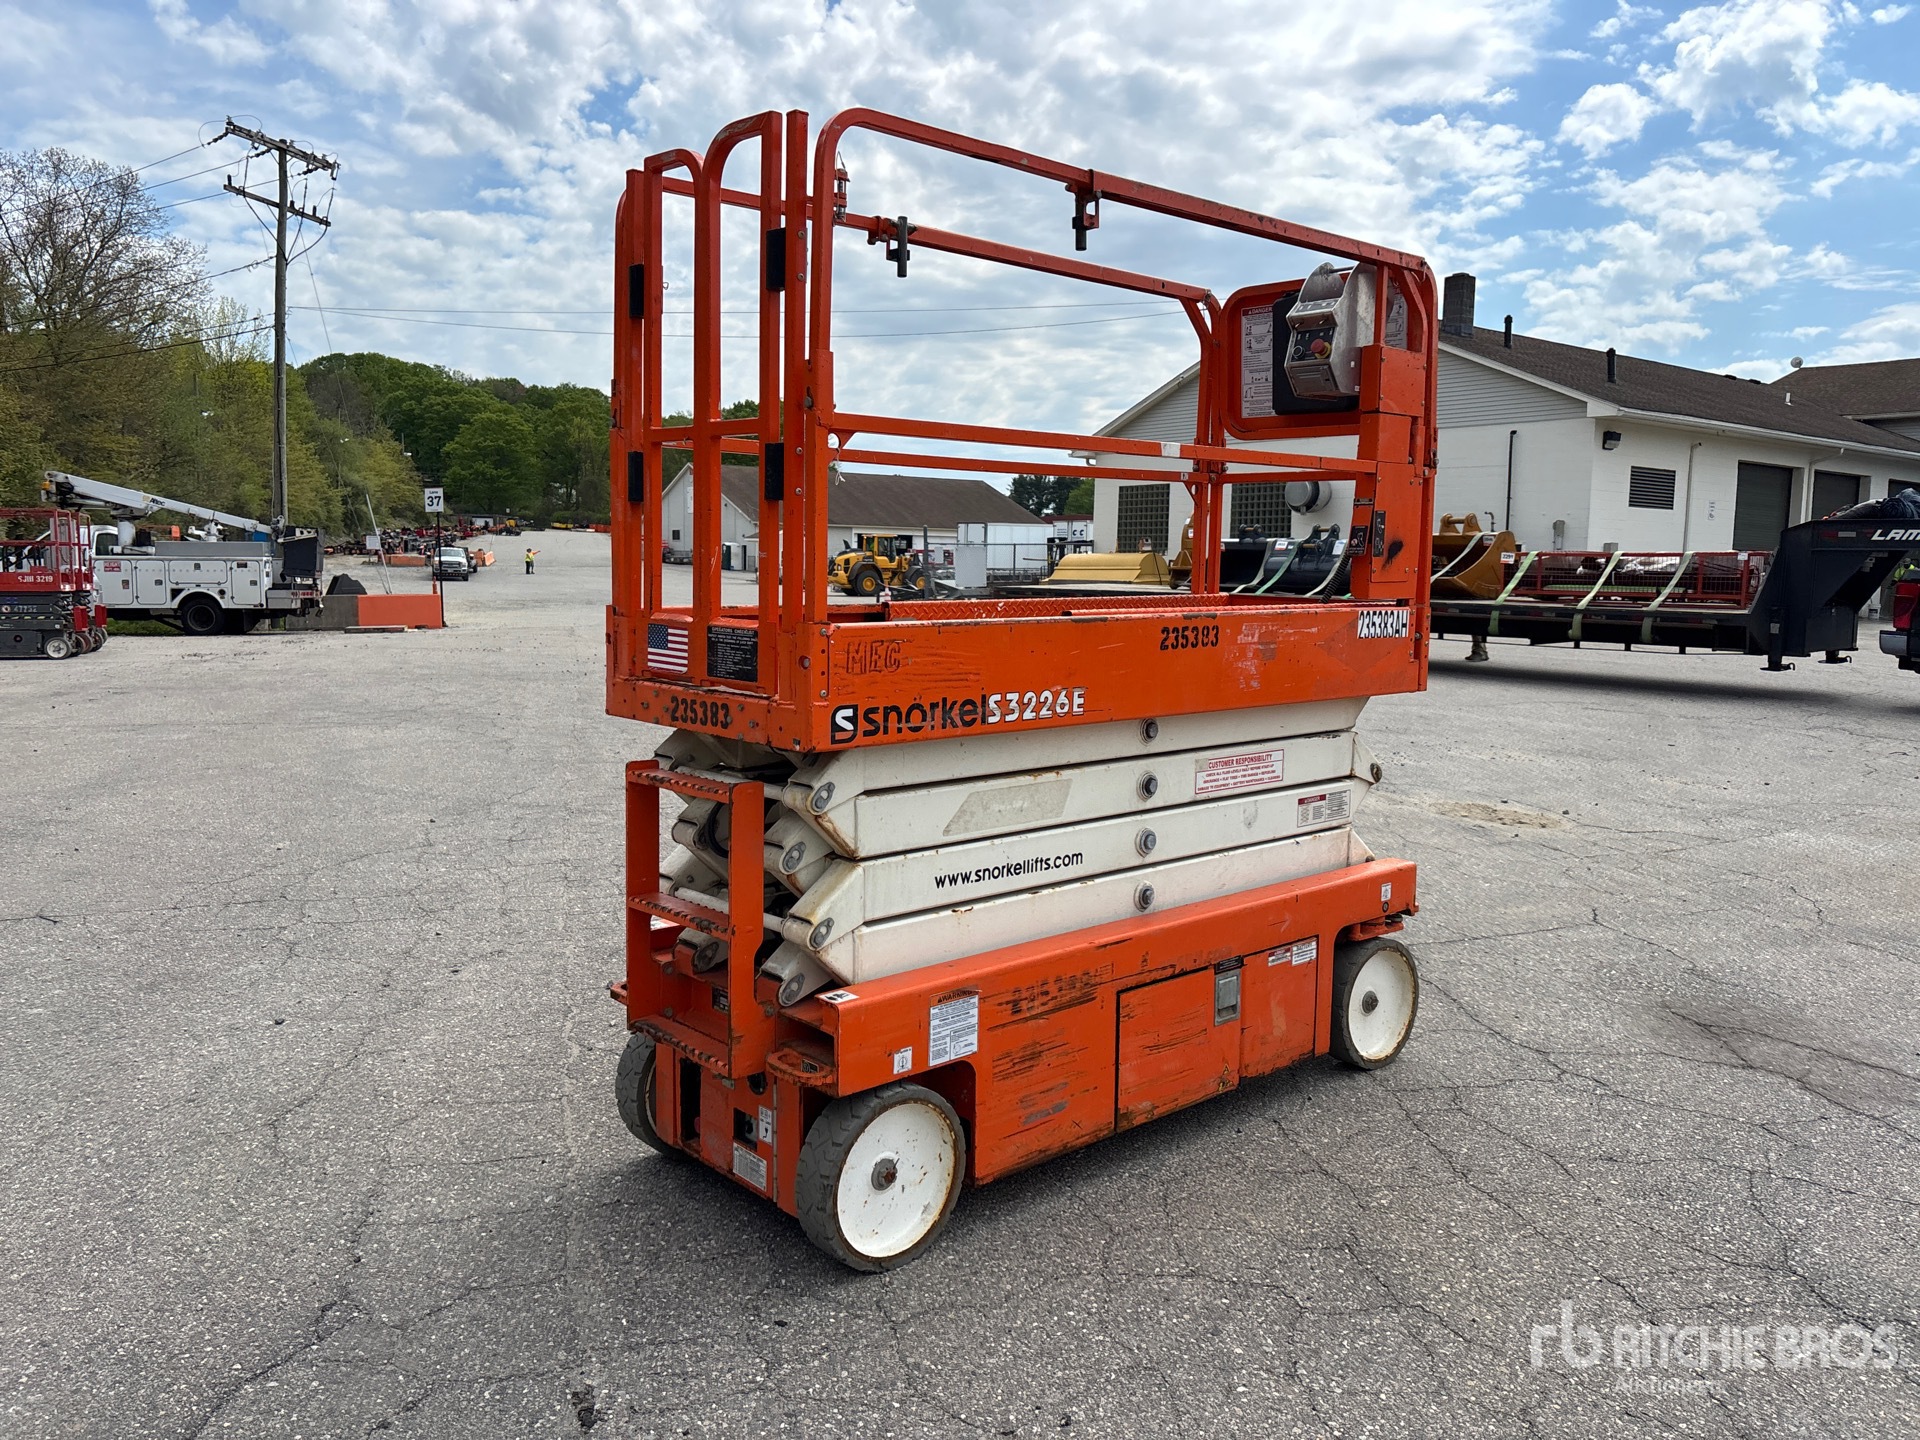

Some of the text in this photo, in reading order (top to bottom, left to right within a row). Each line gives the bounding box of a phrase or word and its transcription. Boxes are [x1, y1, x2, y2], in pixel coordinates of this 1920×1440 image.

[427, 496, 442, 506] 37
[1160, 625, 1219, 651] 235383
[1359, 610, 1408, 639] 235383AH
[846, 638, 902, 675] MEC
[670, 695, 730, 730] 235383
[862, 694, 987, 738] snorkel
[986, 687, 1085, 724] S3226E
[1208, 753, 1272, 768] CUSTOMER RESPONSIBILITY
[934, 852, 1084, 889] www.snorkellifts.com
[942, 989, 974, 1001] WARNING
